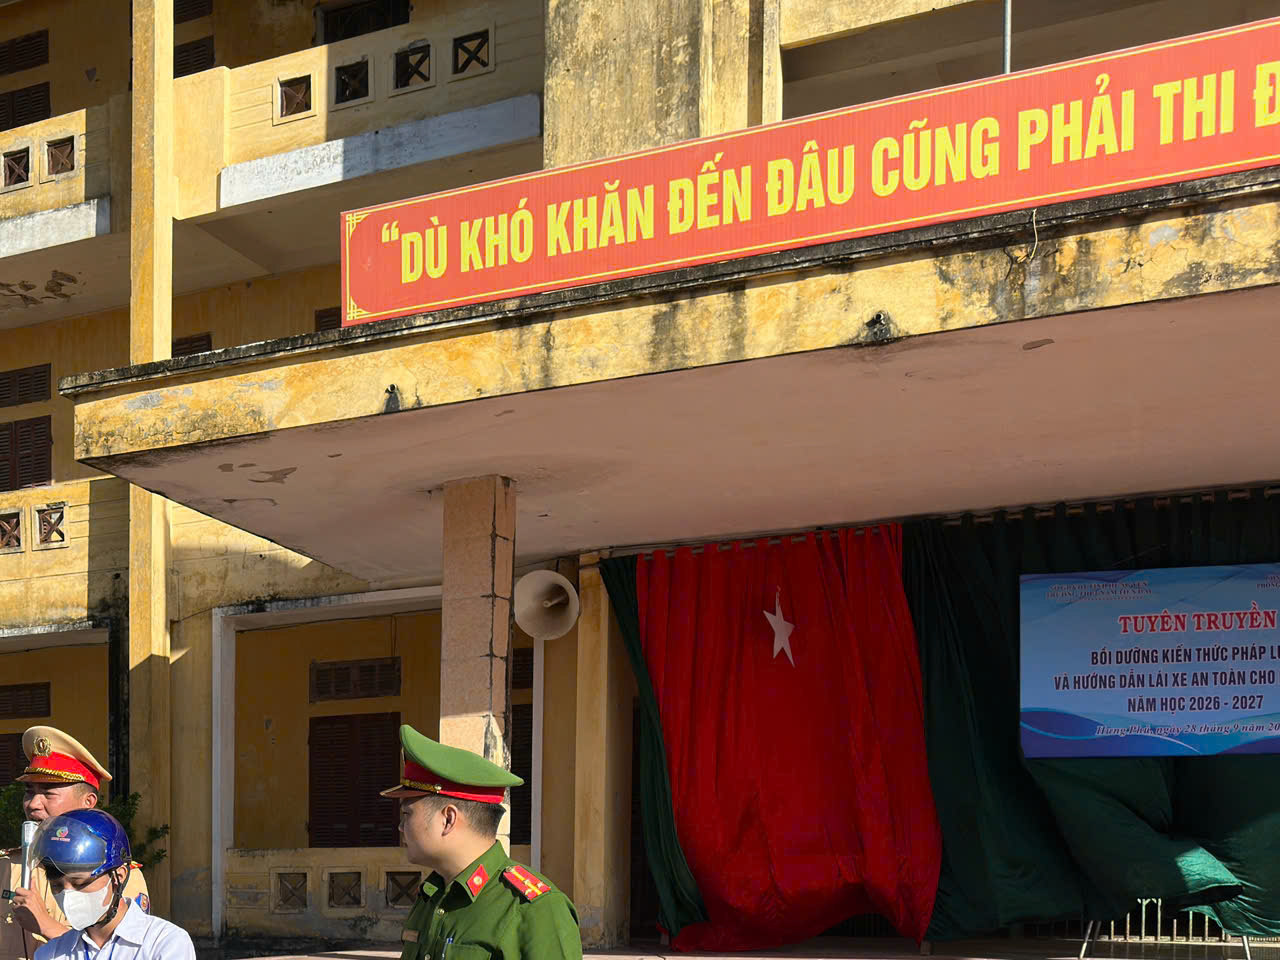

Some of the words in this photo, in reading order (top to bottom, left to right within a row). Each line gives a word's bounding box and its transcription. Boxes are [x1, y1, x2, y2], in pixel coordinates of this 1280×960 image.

[460, 198, 533, 273] KHÓ
[547, 179, 654, 257] KHĂN
[667, 152, 752, 235] ĐẾN
[765, 140, 855, 217] ĐÂU
[871, 117, 1000, 197] CŨNG
[1018, 73, 1135, 170] PHẢI
[1153, 69, 1235, 145] THI
[1118, 609, 1187, 633] TUYÊN
[1192, 600, 1277, 632] TRUYỀN
[1116, 646, 1159, 665] DƯỠNG
[1162, 643, 1192, 663] KIẾN
[1195, 644, 1228, 662] THỨC
[1232, 642, 1266, 661] PHÁP
[1054, 673, 1070, 690] VÀ
[1073, 672, 1116, 690] HƯỚNG
[1119, 668, 1145, 689] DẪN
[1148, 669, 1168, 688] LÁI
[1172, 672, 1188, 687] XE
[1191, 671, 1209, 687] AN
[1212, 668, 1246, 686] TOÀN
[1249, 669, 1276, 685] CHO
[1127, 695, 1157, 713] NĂM
[1160, 696, 1186, 715] HỌC
[1189, 695, 1221, 711] 2026
[1232, 695, 1264, 710] 2027
[1184, 723, 1197, 733] 28
[1199, 723, 1231, 735] tháng
[1233, 722, 1240, 733] 9
[1241, 723, 1265, 733] năm
